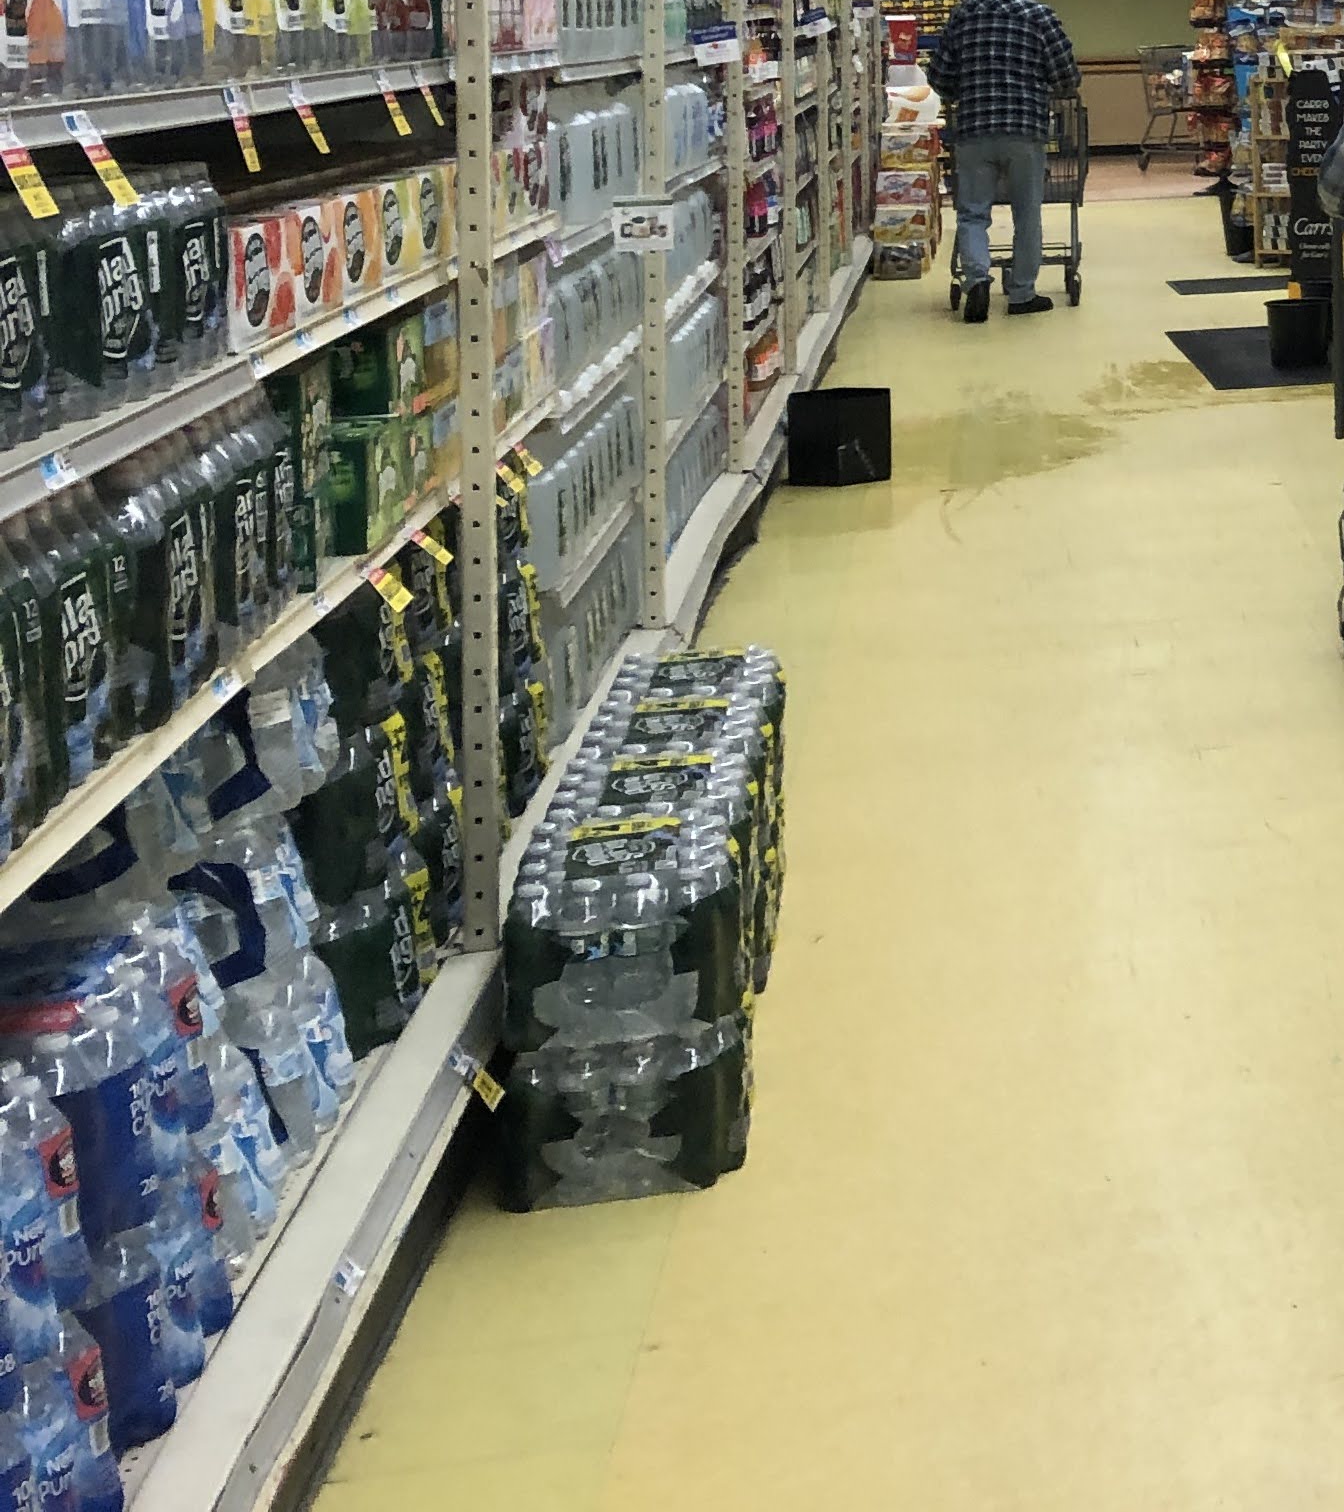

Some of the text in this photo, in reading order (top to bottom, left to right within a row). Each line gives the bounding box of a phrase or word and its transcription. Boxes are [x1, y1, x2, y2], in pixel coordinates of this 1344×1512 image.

[1296, 114, 1330, 123] MAKES
[1304, 127, 1322, 136] THE
[112, 555, 125, 573] 12
